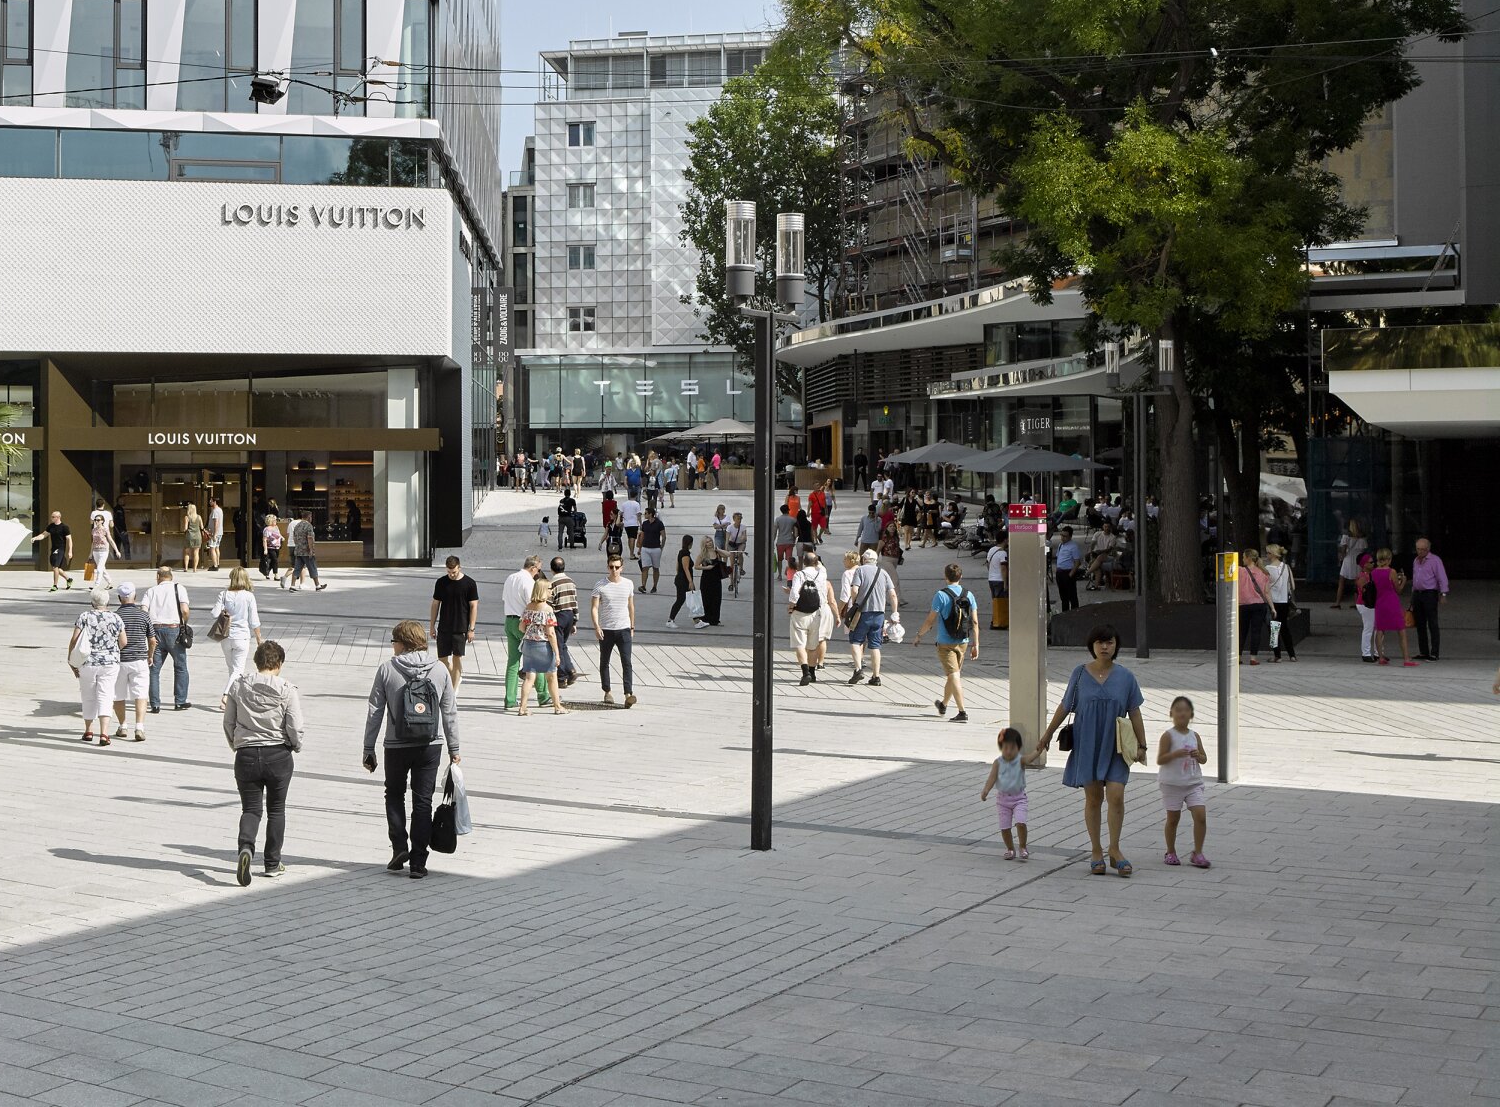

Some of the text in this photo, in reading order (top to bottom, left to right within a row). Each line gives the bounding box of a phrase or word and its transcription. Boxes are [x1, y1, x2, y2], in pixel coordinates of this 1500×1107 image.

[221, 202, 426, 229] LOUIS VUITTON
[592, 379, 743, 395] TESL
[1026, 417, 1051, 430] TIGER
[148, 433, 257, 445] LOUIS VUITTON
